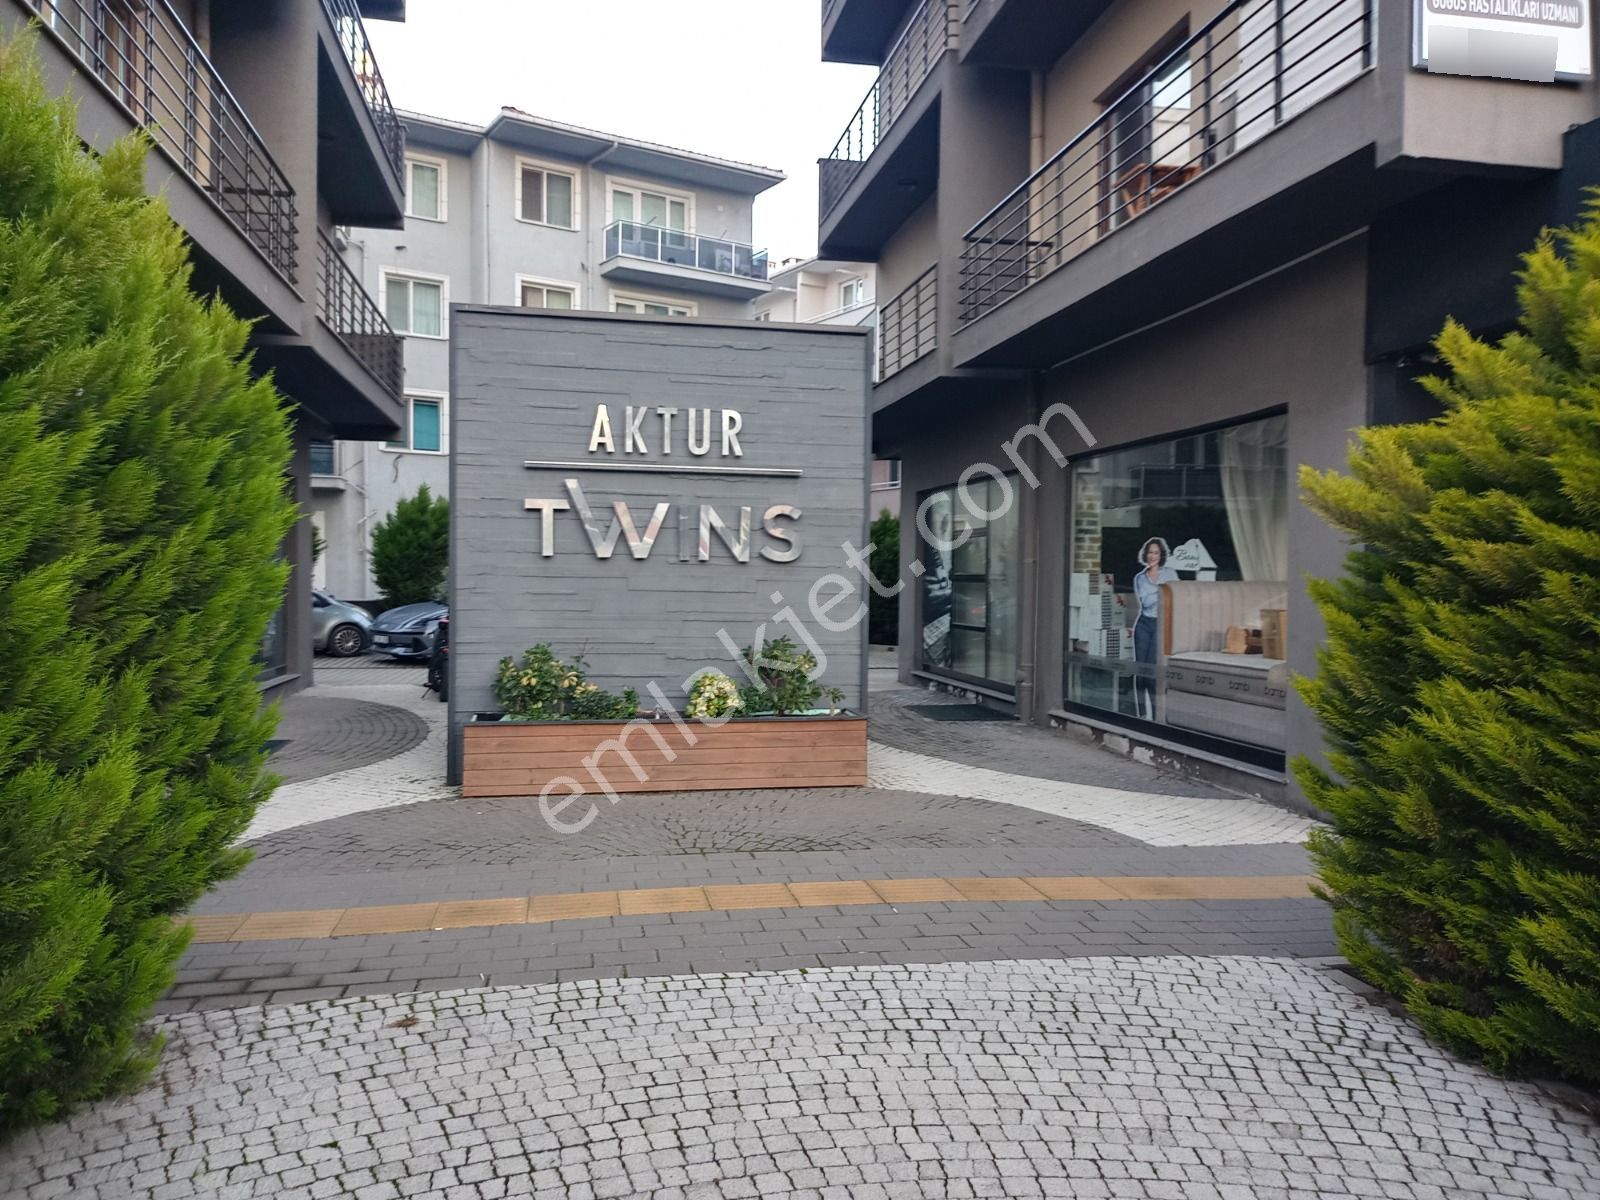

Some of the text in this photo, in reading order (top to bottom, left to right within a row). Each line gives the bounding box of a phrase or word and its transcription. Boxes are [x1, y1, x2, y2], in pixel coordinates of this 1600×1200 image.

[1469, 0, 1540, 19] HASTALIKLARI
[1541, 2, 1579, 24] UZMANI
[588, 403, 743, 456] AKTUR
[523, 478, 803, 563] TWINS
